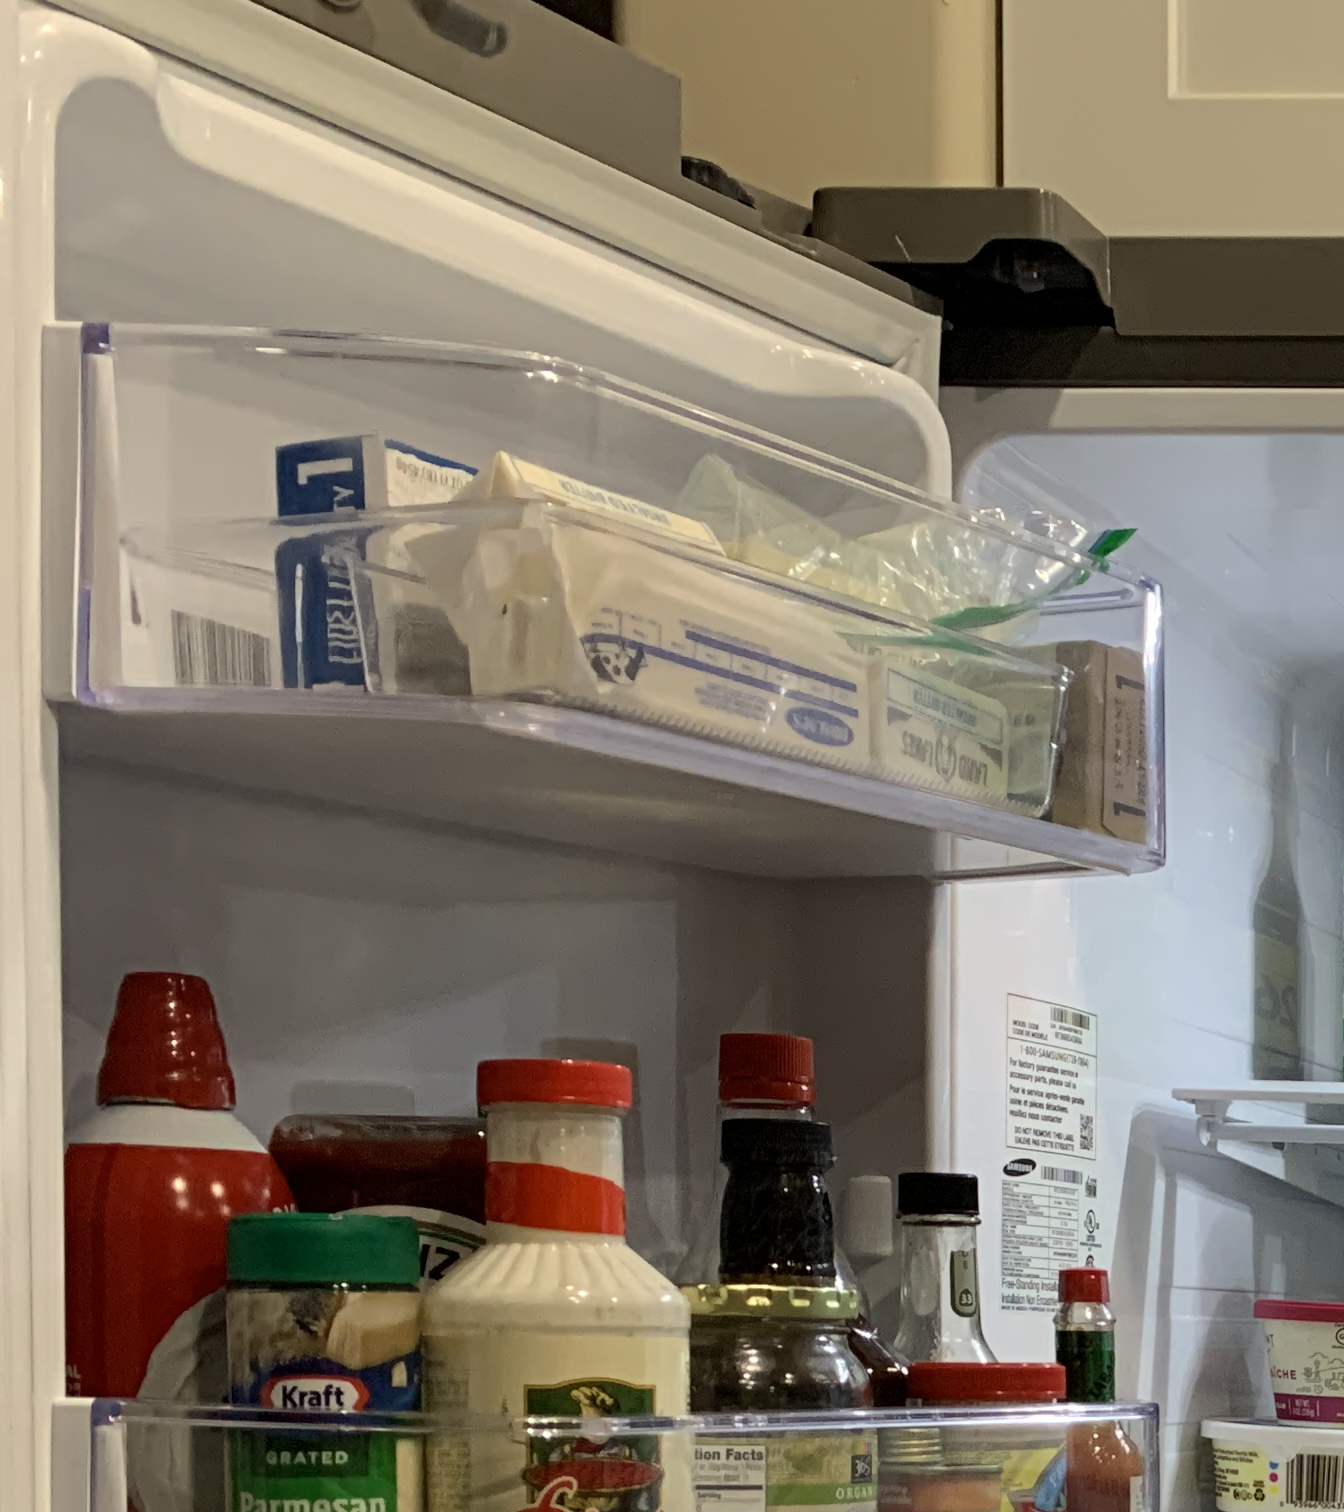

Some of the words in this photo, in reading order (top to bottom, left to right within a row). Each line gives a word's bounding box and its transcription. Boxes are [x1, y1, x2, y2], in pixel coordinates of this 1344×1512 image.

[1009, 1057, 1018, 1067] For
[1018, 1059, 1035, 1073] factory
[1036, 1062, 1059, 1075] guarantee
[1009, 1071, 1033, 1083] accessory
[1048, 1076, 1064, 1088] please
[1009, 1084, 1021, 1096] Pour
[1026, 1087, 1044, 1098] service
[1014, 1126, 1022, 1135] DO
[1022, 1126, 1032, 1136] NOT
[1033, 1128, 1051, 1139] REMOVE
[1052, 1130, 1062, 1140] THIS
[1063, 1132, 1075, 1142] LABEL
[1001, 1277, 1040, 1294] Free-Standing
[1001, 1292, 1025, 1305] Installation
[281, 1385, 345, 1408] Kraft
[265, 1450, 349, 1466] GRATED
[726, 1448, 764, 1462] Facts
[853, 1458, 873, 1477] 365
